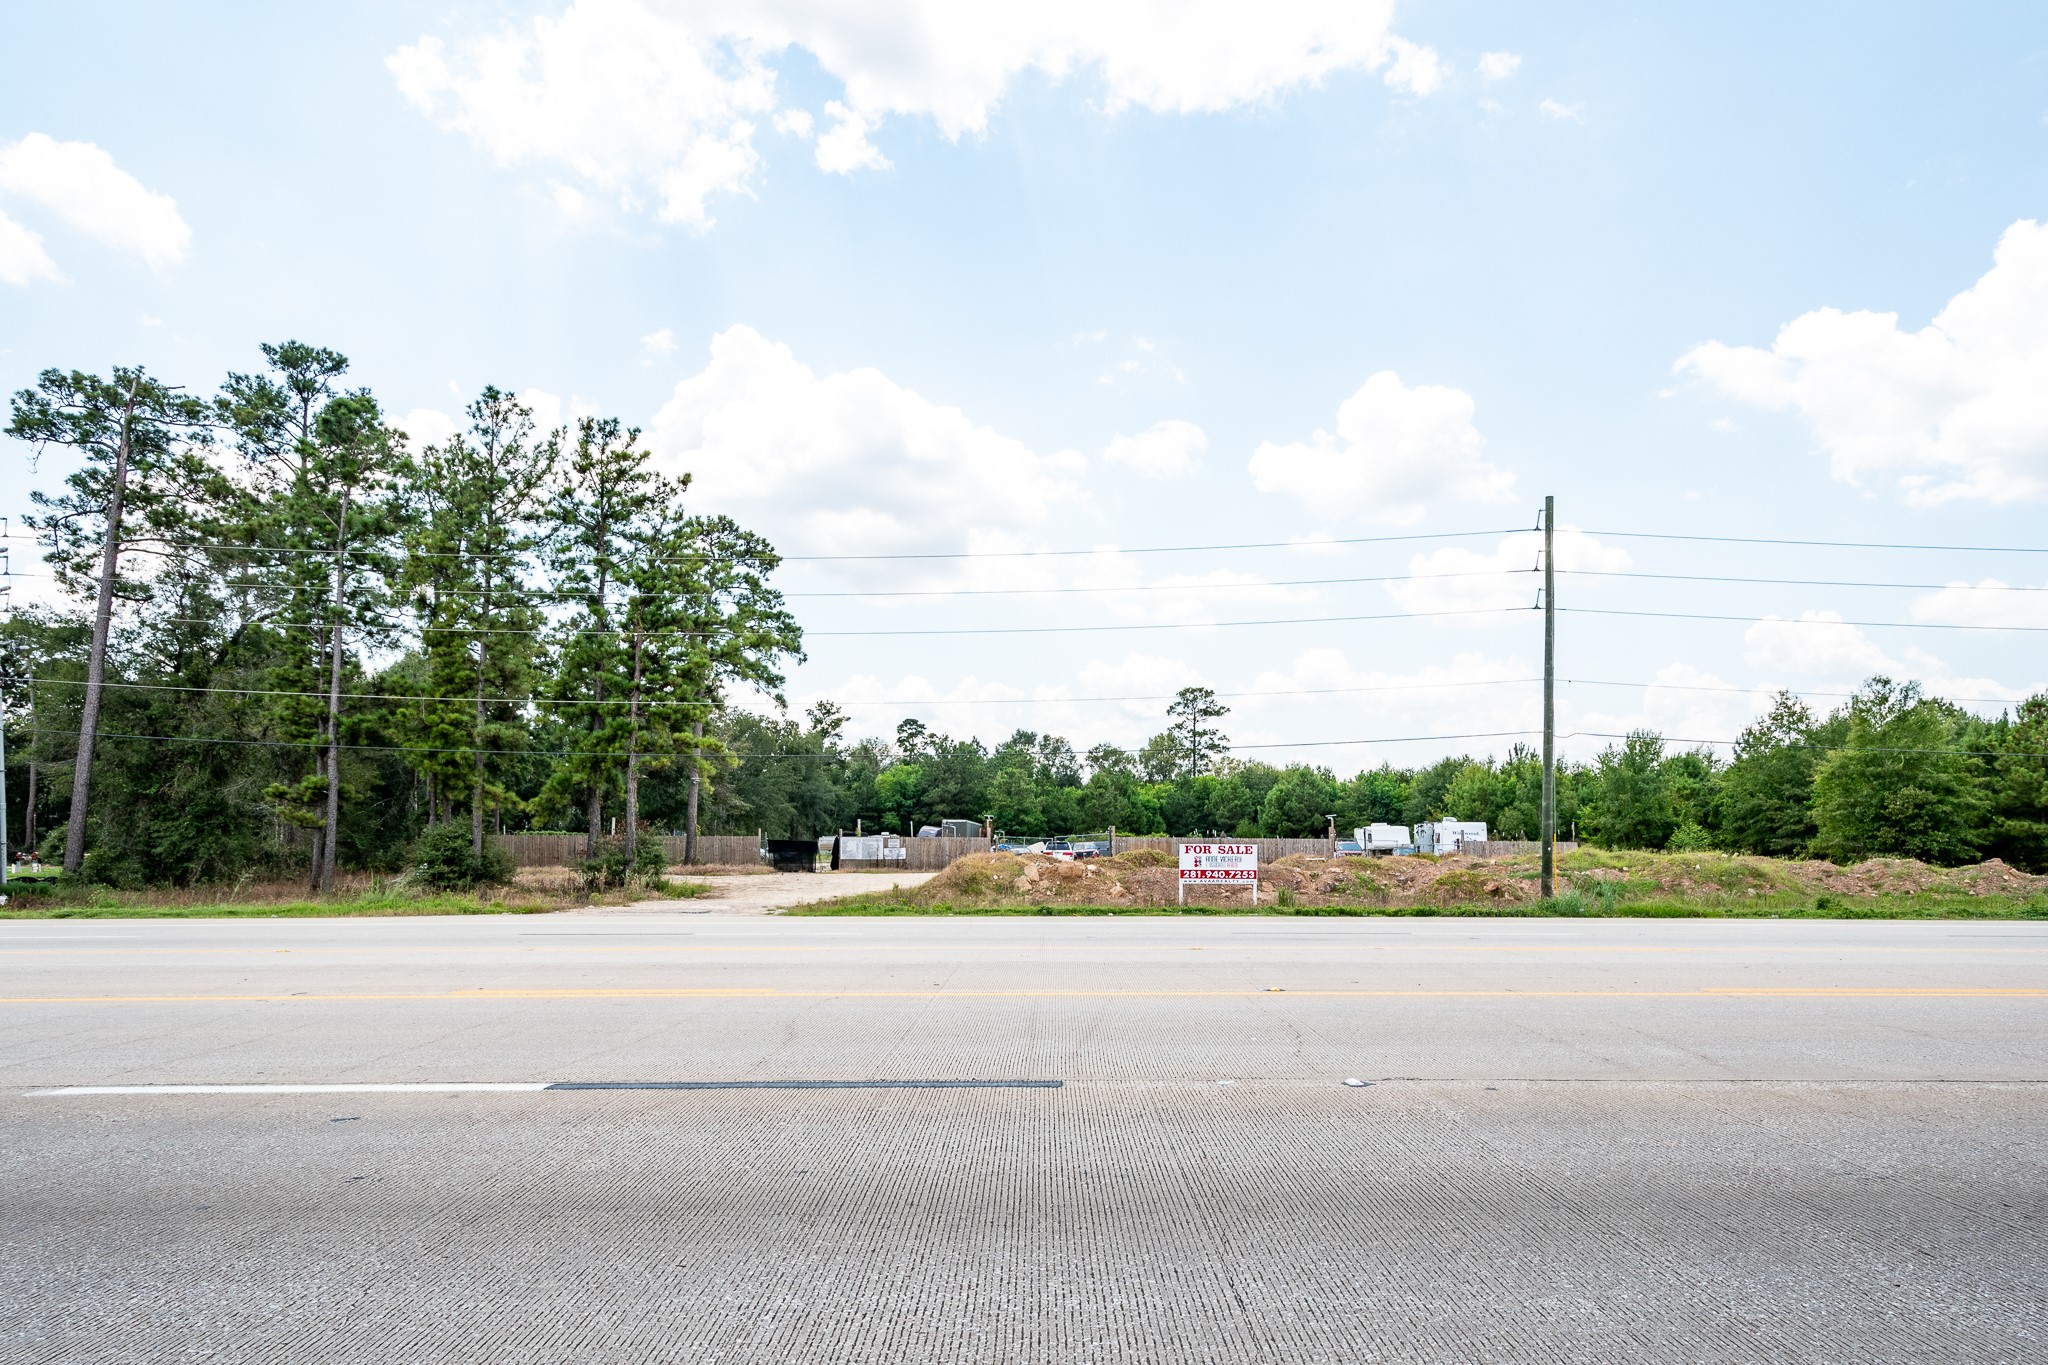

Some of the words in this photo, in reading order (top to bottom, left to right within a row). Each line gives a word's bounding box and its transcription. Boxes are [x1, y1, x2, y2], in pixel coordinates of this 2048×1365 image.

[1184, 845, 1212, 854] FOR
[1218, 845, 1253, 854] SALE
[1183, 870, 1255, 879] 281.940.7253
